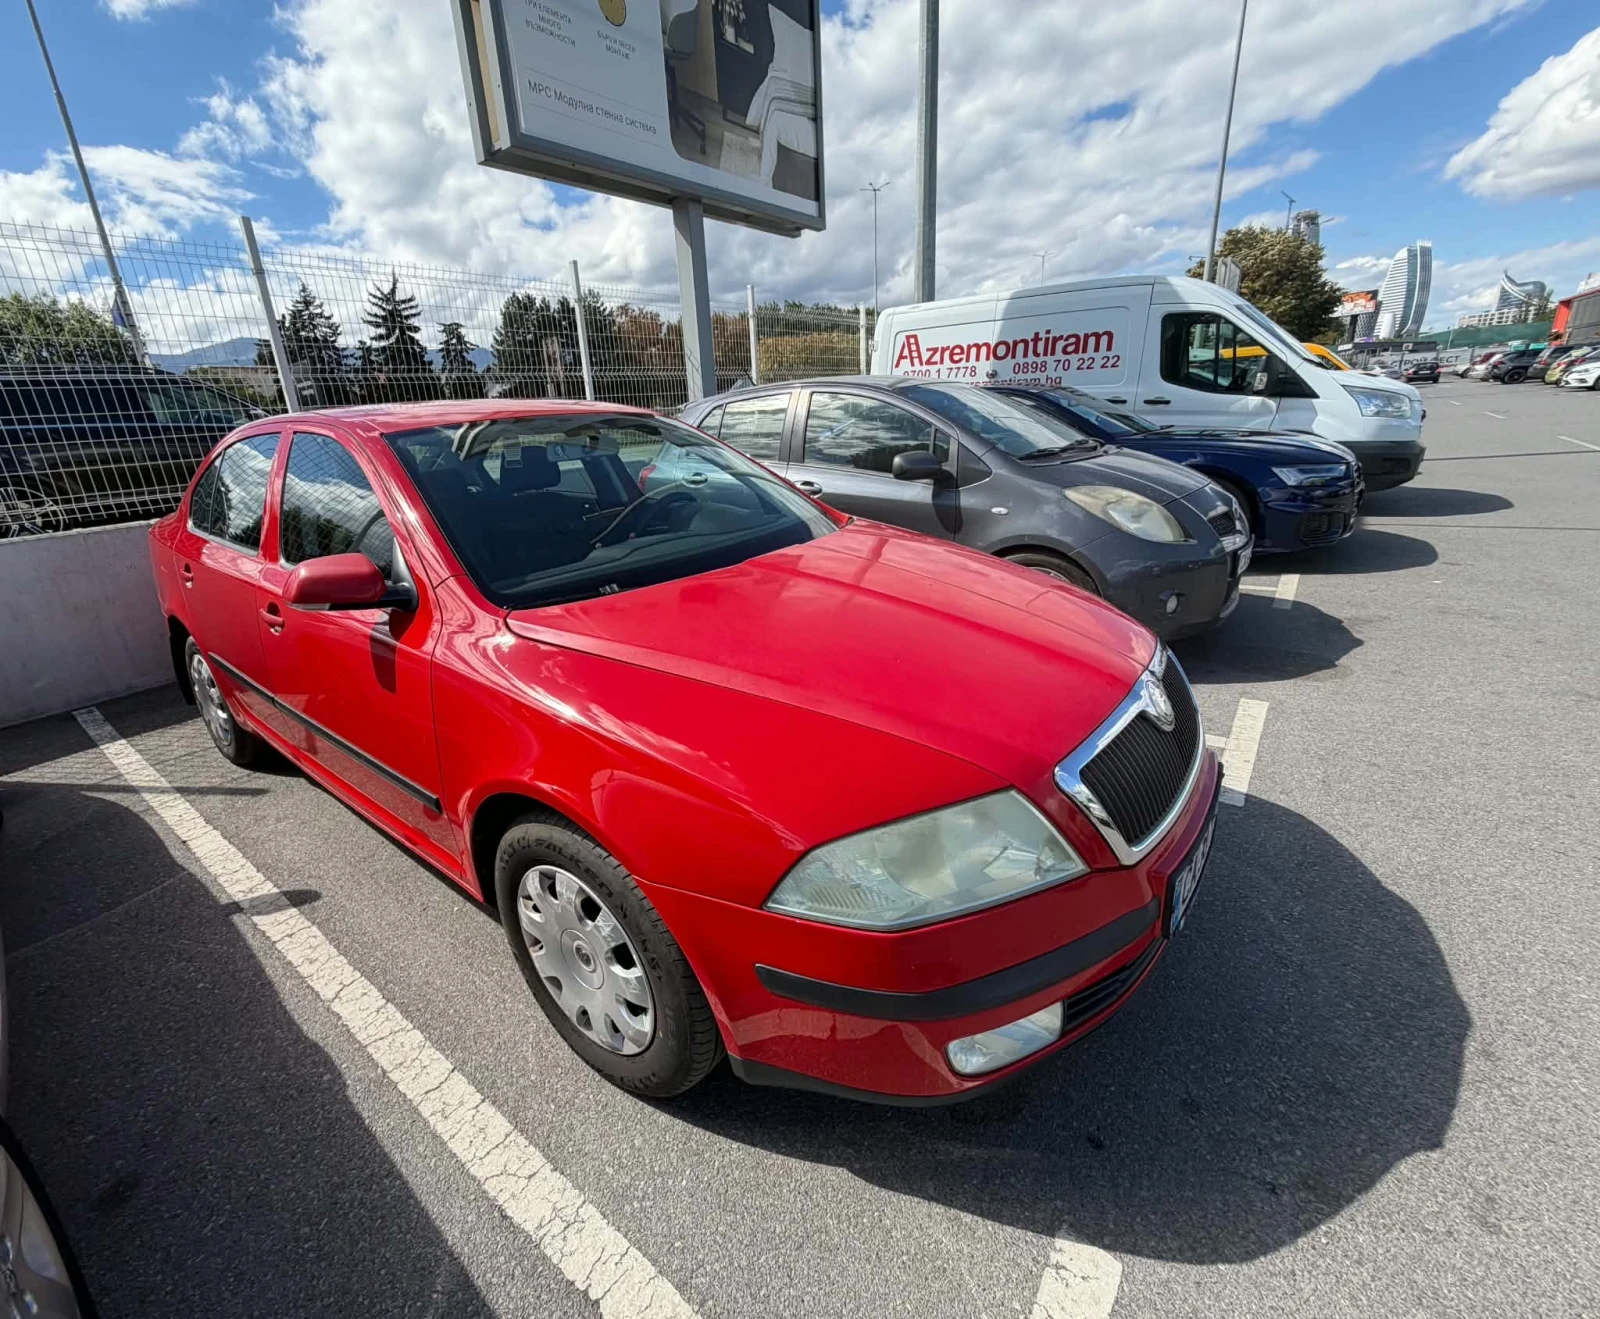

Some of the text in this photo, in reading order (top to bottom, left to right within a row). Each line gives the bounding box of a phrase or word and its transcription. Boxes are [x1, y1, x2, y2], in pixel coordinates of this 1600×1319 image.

[538, 3, 572, 26] ЕЛЕМЕНТА
[538, 13, 562, 31] МНОГО
[525, 18, 576, 48] ВЪЗМОЖНОСТИ
[553, 89, 594, 114] Модулна
[595, 105, 624, 123] стенна
[625, 117, 657, 135] система
[895, 329, 1114, 368] Azremontiram
[947, 366, 977, 379] 7778
[1013, 355, 1121, 374] 0898 70 22 22
